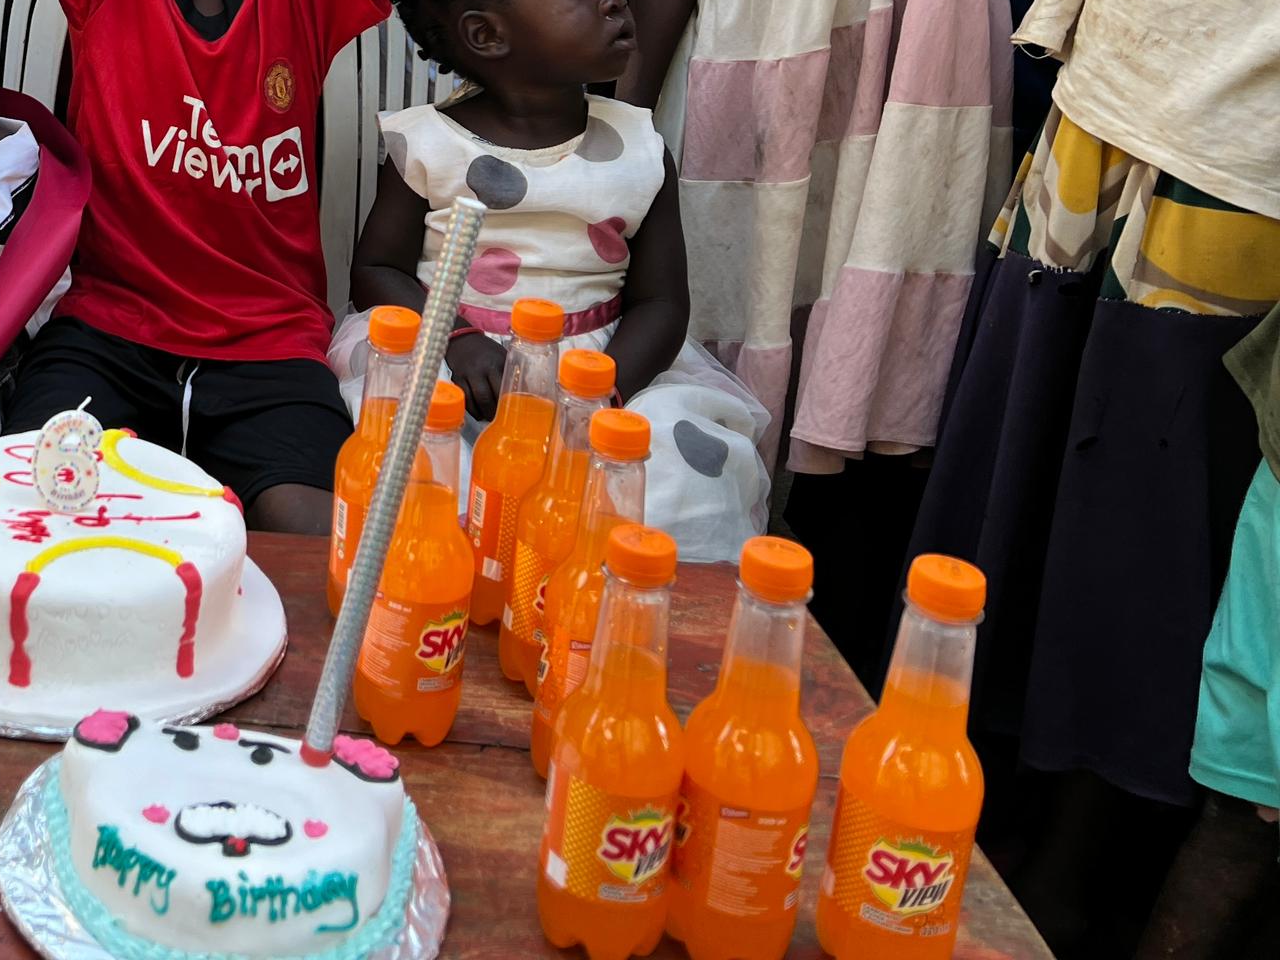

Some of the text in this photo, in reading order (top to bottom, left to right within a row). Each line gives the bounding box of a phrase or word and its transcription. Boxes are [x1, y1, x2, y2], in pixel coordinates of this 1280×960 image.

[141, 118, 263, 198] Viewr
[183, 95, 261, 175] Tem
[601, 821, 671, 862] SKY
[865, 850, 950, 890] SKY
[206, 869, 360, 933] Birthday
